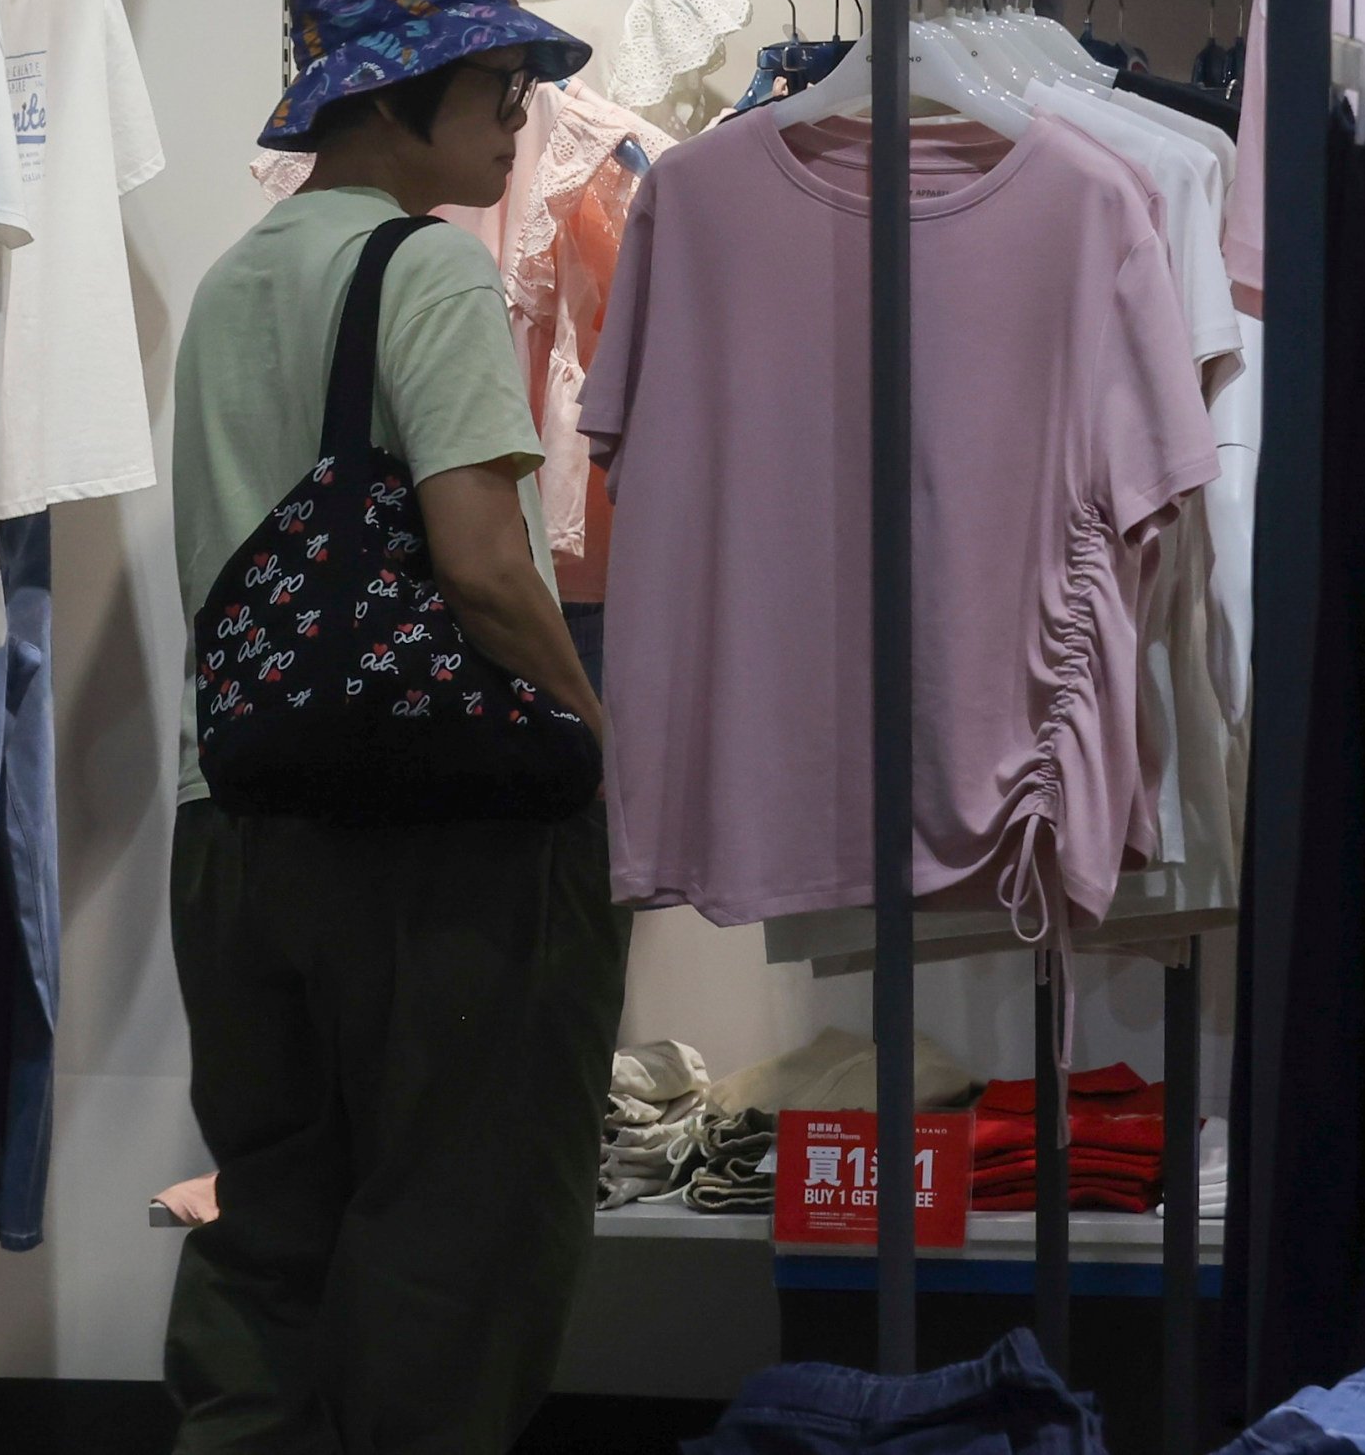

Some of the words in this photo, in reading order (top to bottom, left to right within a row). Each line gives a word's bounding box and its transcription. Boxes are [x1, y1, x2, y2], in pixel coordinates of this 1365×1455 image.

[804, 1188, 837, 1205] BUY
[838, 1191, 846, 1205] 1
[851, 1190, 878, 1206] GET
